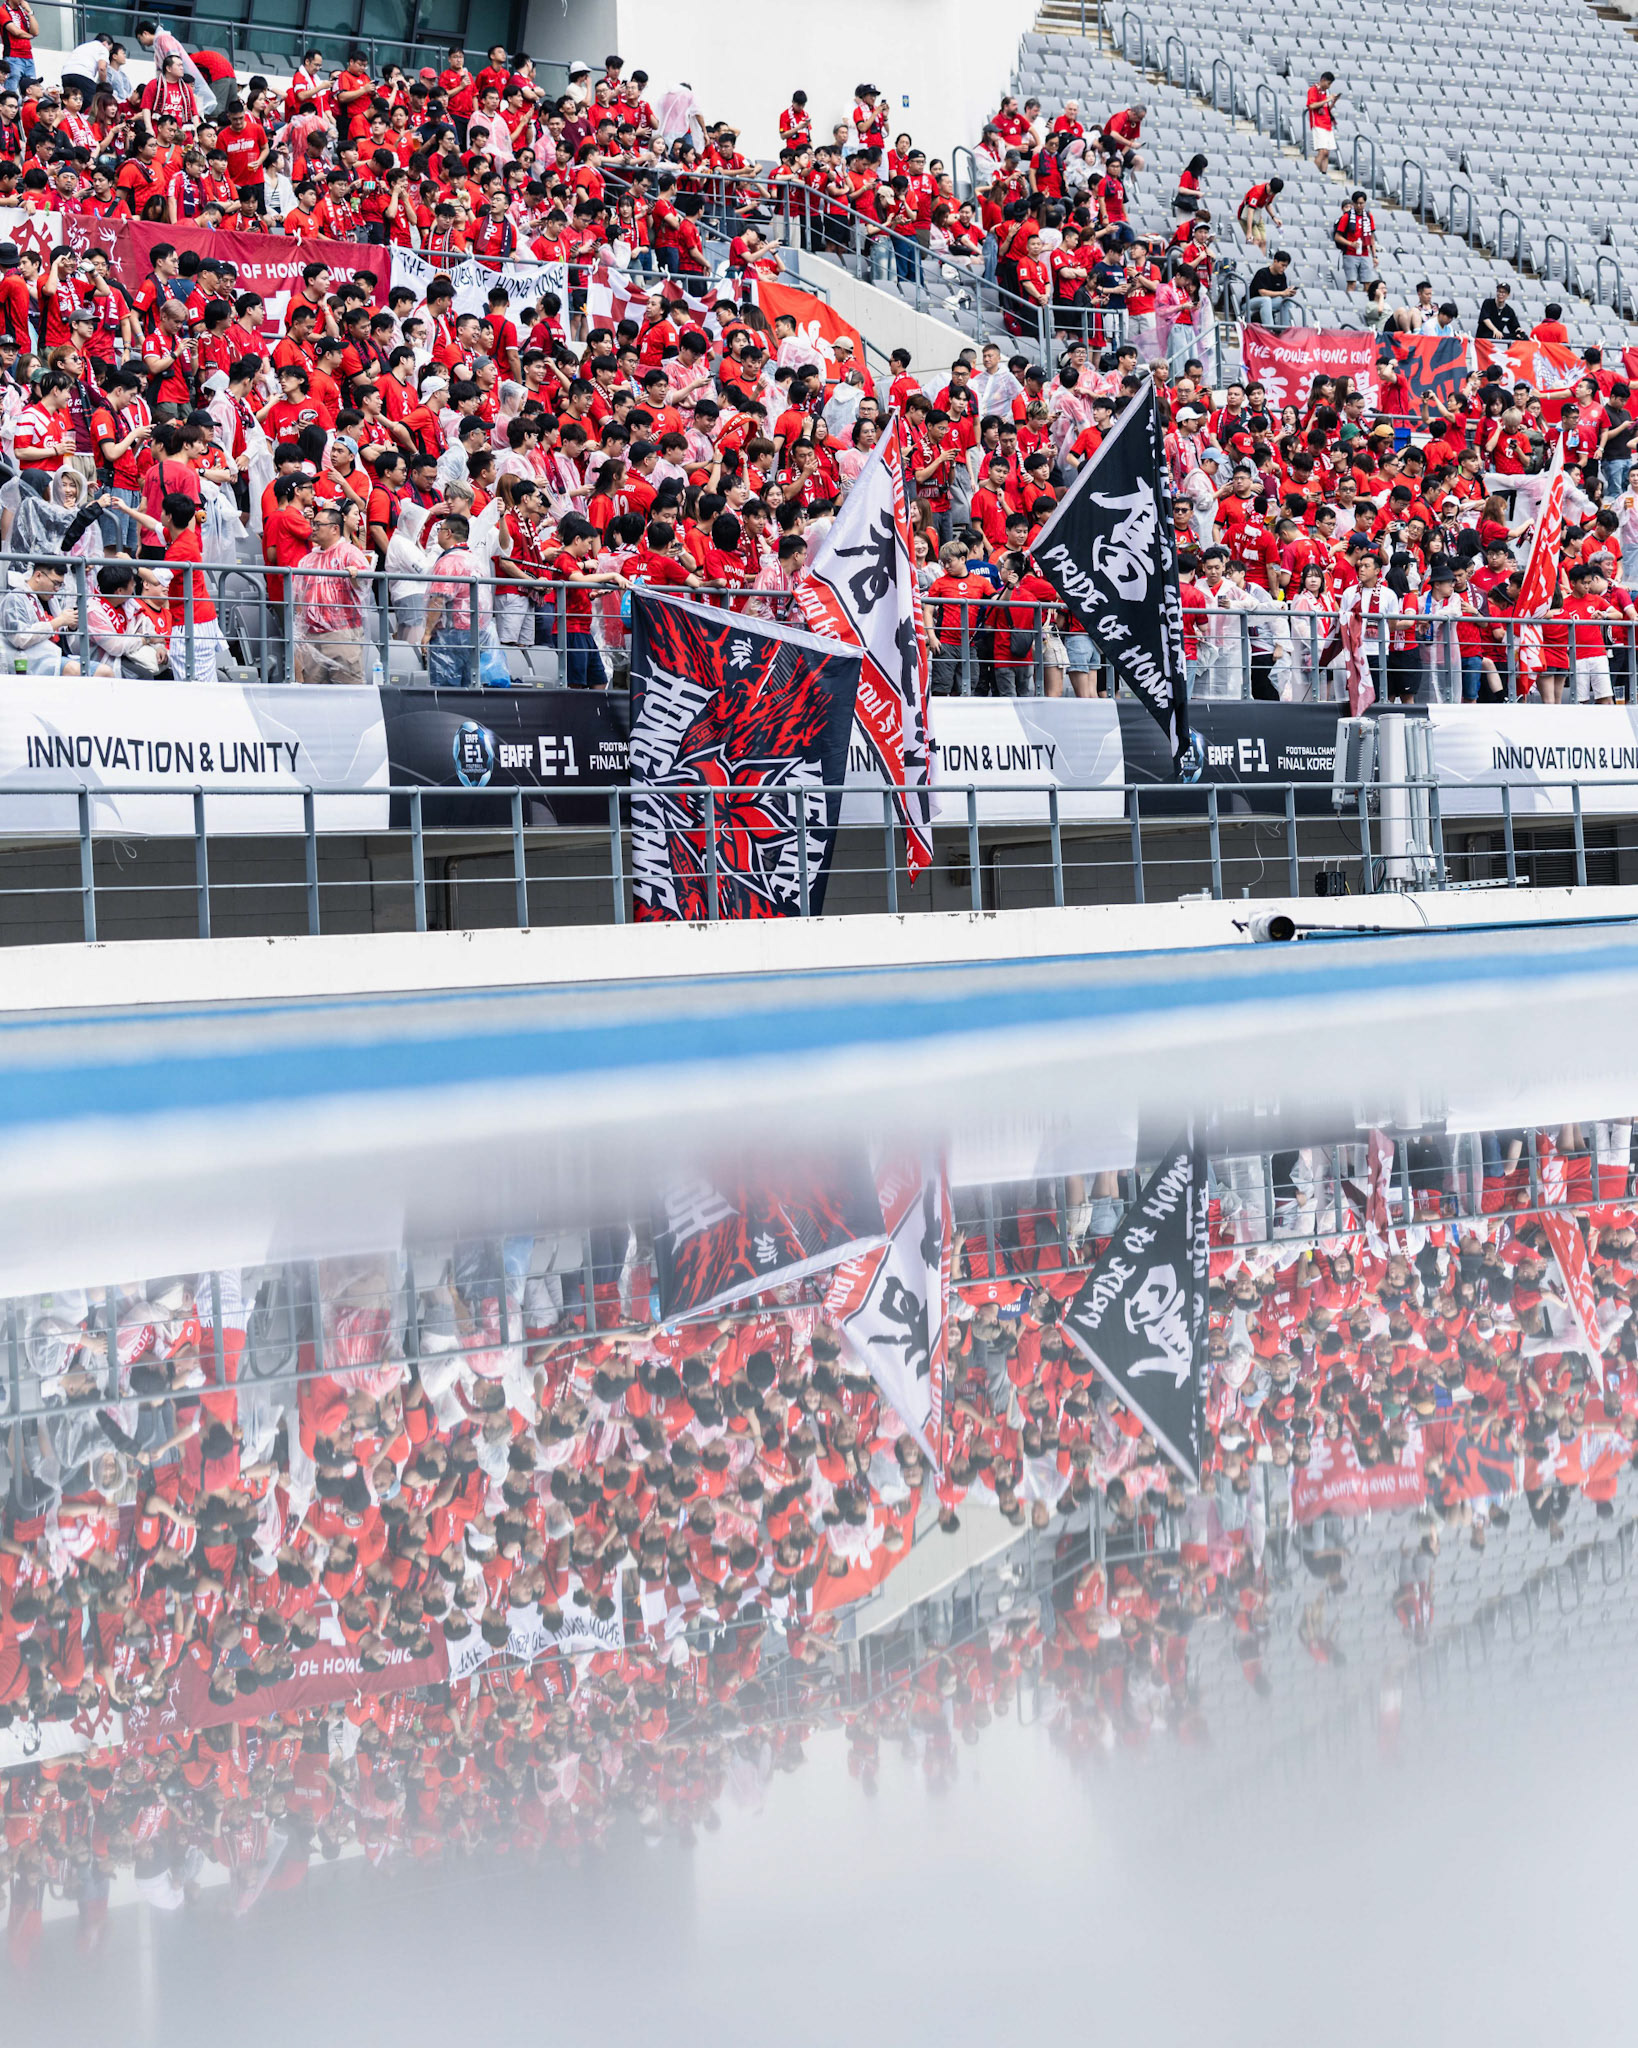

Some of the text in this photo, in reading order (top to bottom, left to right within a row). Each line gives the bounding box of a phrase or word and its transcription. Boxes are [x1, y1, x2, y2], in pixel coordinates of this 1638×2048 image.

[242, 263, 262, 279] OF
[265, 261, 307, 279] HONG
[1249, 342, 1270, 359] THE
[1042, 543, 1169, 709] PRIDE OF HONG
[465, 734, 479, 743] EAFF
[599, 742, 630, 752] FOOTBA
[27, 735, 300, 773] INNOVATION & UNITY
[500, 735, 579, 776] EAFF E-1
[982, 745, 993, 770] &
[997, 744, 1056, 771] UNITY
[1207, 738, 1270, 773] EAFF E-1
[1286, 746, 1336, 756] FOOTBALL CHAM
[1493, 746, 1596, 769] INNOVATION
[1600, 747, 1608, 768] &
[589, 754, 631, 770] FINAL K
[1278, 756, 1305, 771] FINAL
